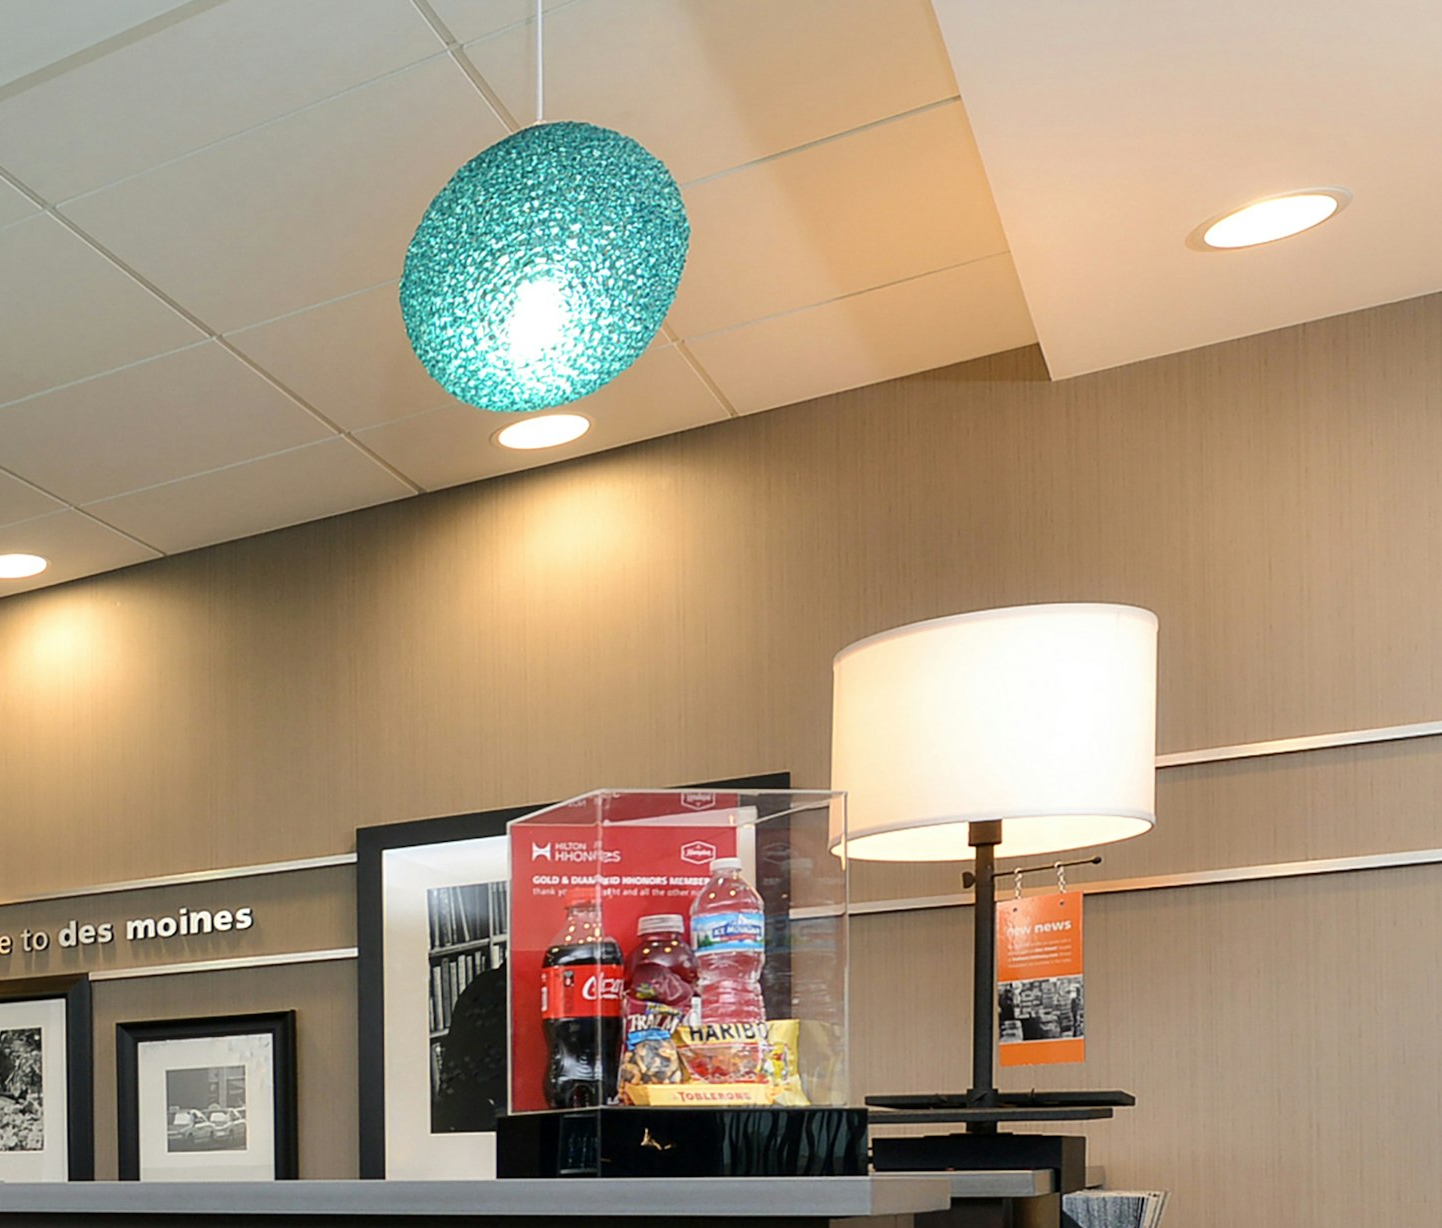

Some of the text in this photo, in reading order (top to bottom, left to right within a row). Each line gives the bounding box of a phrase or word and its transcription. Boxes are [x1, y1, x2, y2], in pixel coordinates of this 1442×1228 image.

[554, 842, 587, 850] HILTON
[532, 875, 560, 885] GOLD
[561, 875, 570, 885] &
[570, 874, 621, 886] DIAMND
[532, 887, 556, 896] thank
[622, 887, 638, 897] and
[639, 887, 650, 897] all
[651, 888, 665, 897] the
[666, 888, 689, 897] other
[20, 928, 50, 952] to
[58, 921, 114, 948] des
[126, 907, 254, 941] moines
[1034, 919, 1073, 935] news
[689, 1022, 769, 1042] HARIBO
